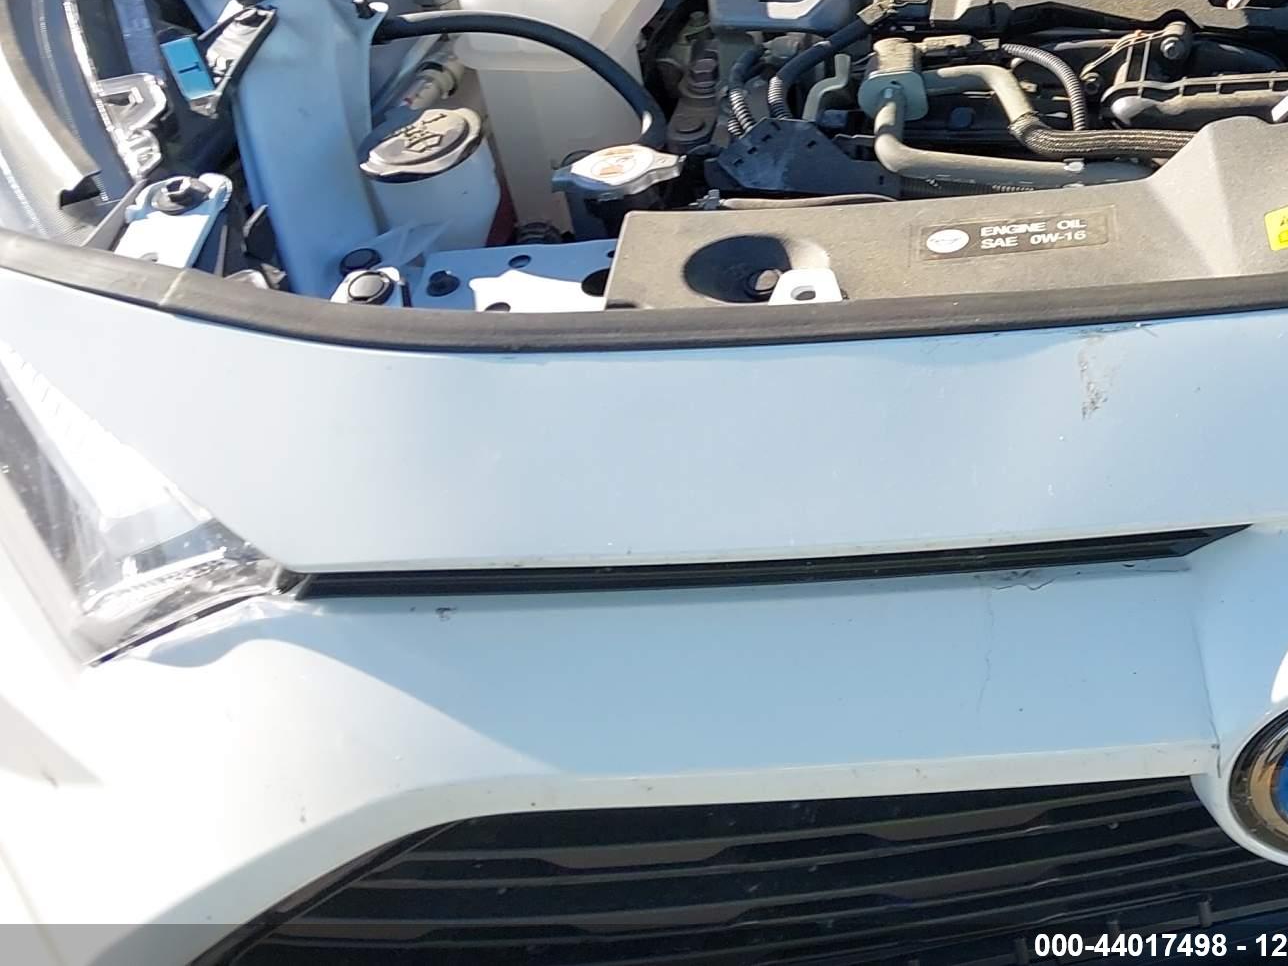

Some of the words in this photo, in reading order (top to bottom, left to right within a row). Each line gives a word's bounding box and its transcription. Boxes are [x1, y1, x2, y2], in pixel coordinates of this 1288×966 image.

[980, 221, 1048, 237] ENGINE
[1056, 218, 1087, 230] OIL
[980, 236, 1019, 250] SAE
[1029, 230, 1087, 245] 0W-16
